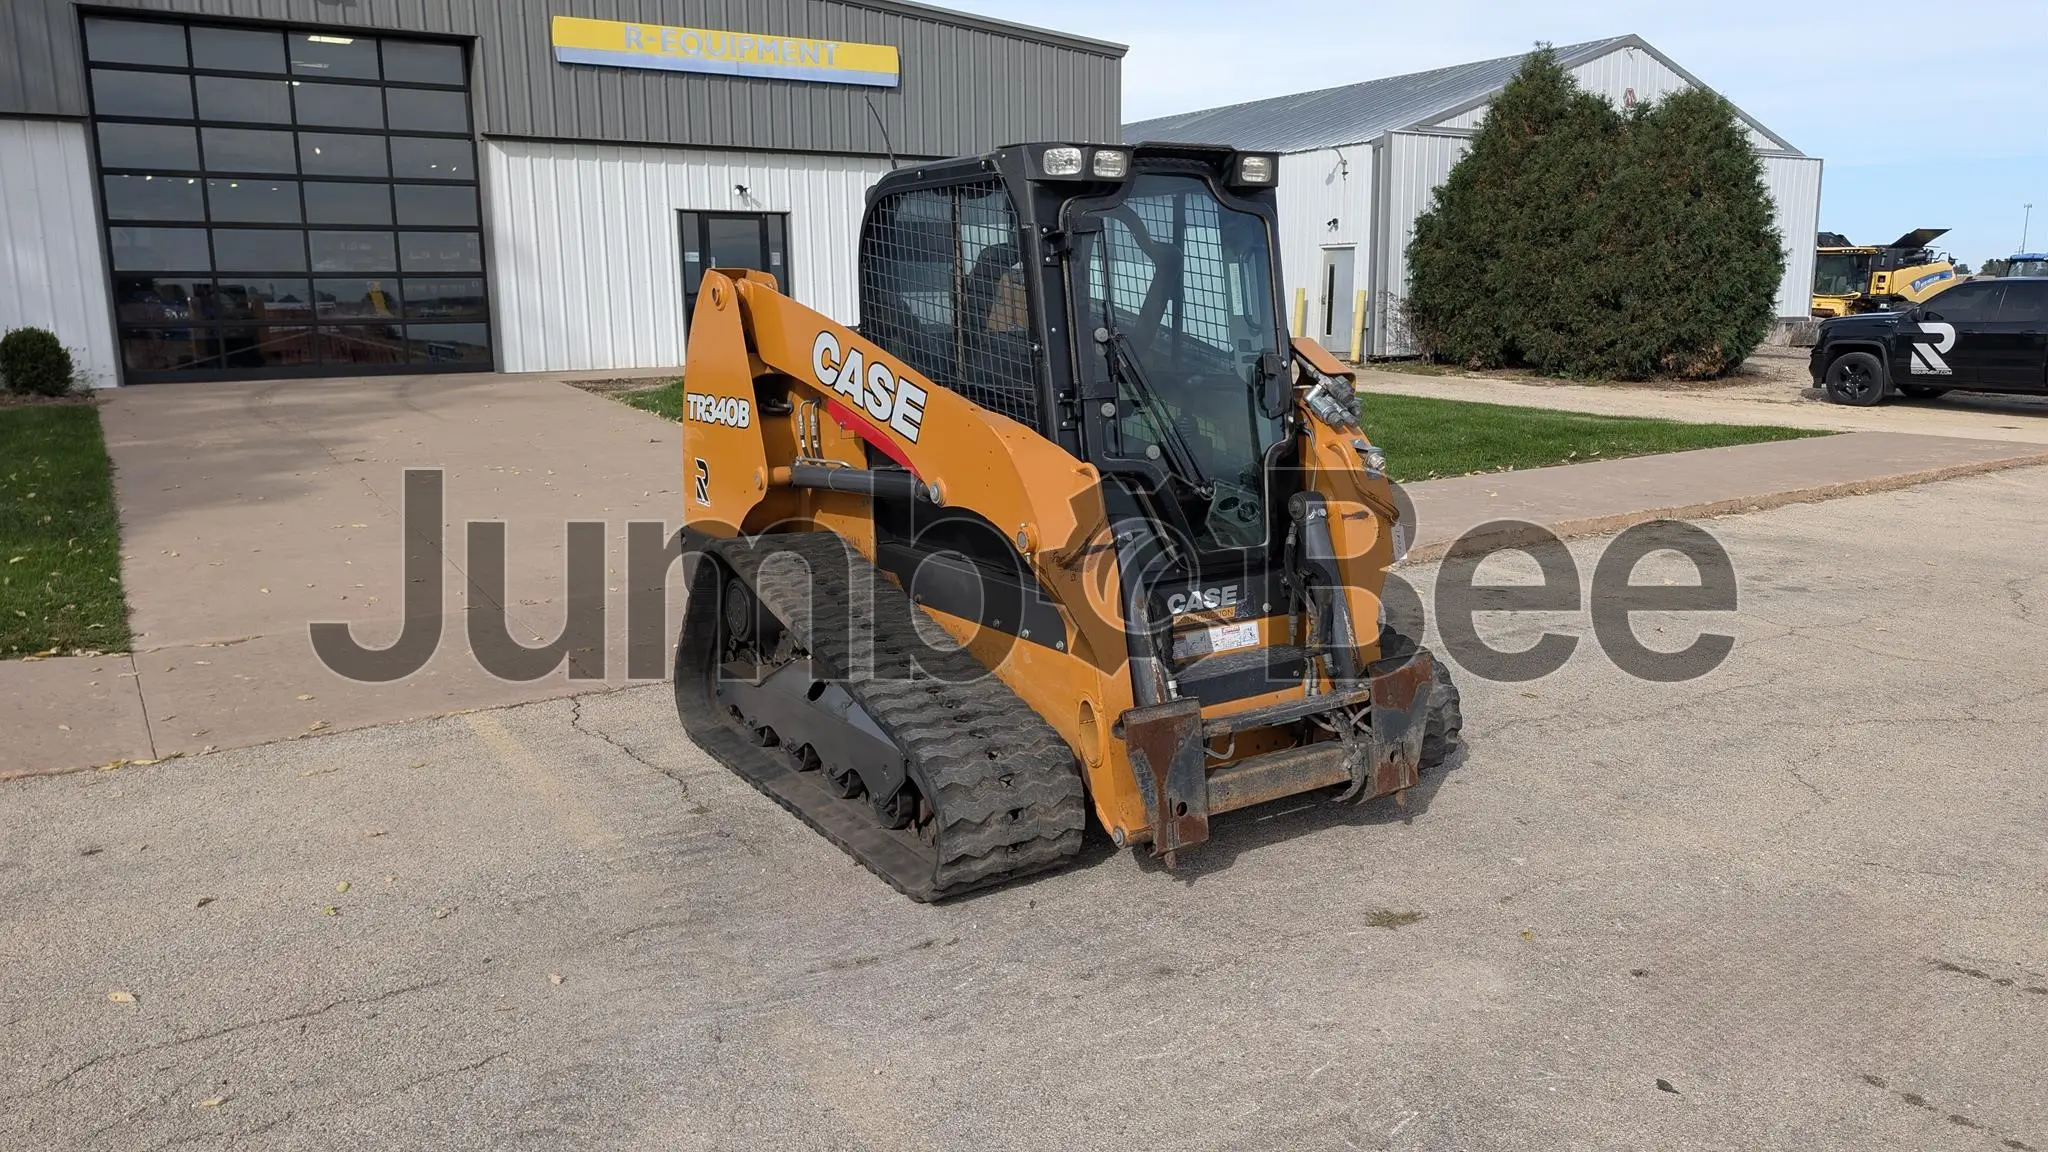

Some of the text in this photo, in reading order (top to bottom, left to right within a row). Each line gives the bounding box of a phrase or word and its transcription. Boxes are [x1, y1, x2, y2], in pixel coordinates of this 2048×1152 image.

[624, 25, 840, 65] R-EQUIPMENT
[812, 330, 928, 445] CASE
[687, 391, 750, 429] TR340B
[1167, 585, 1237, 614] CASE
